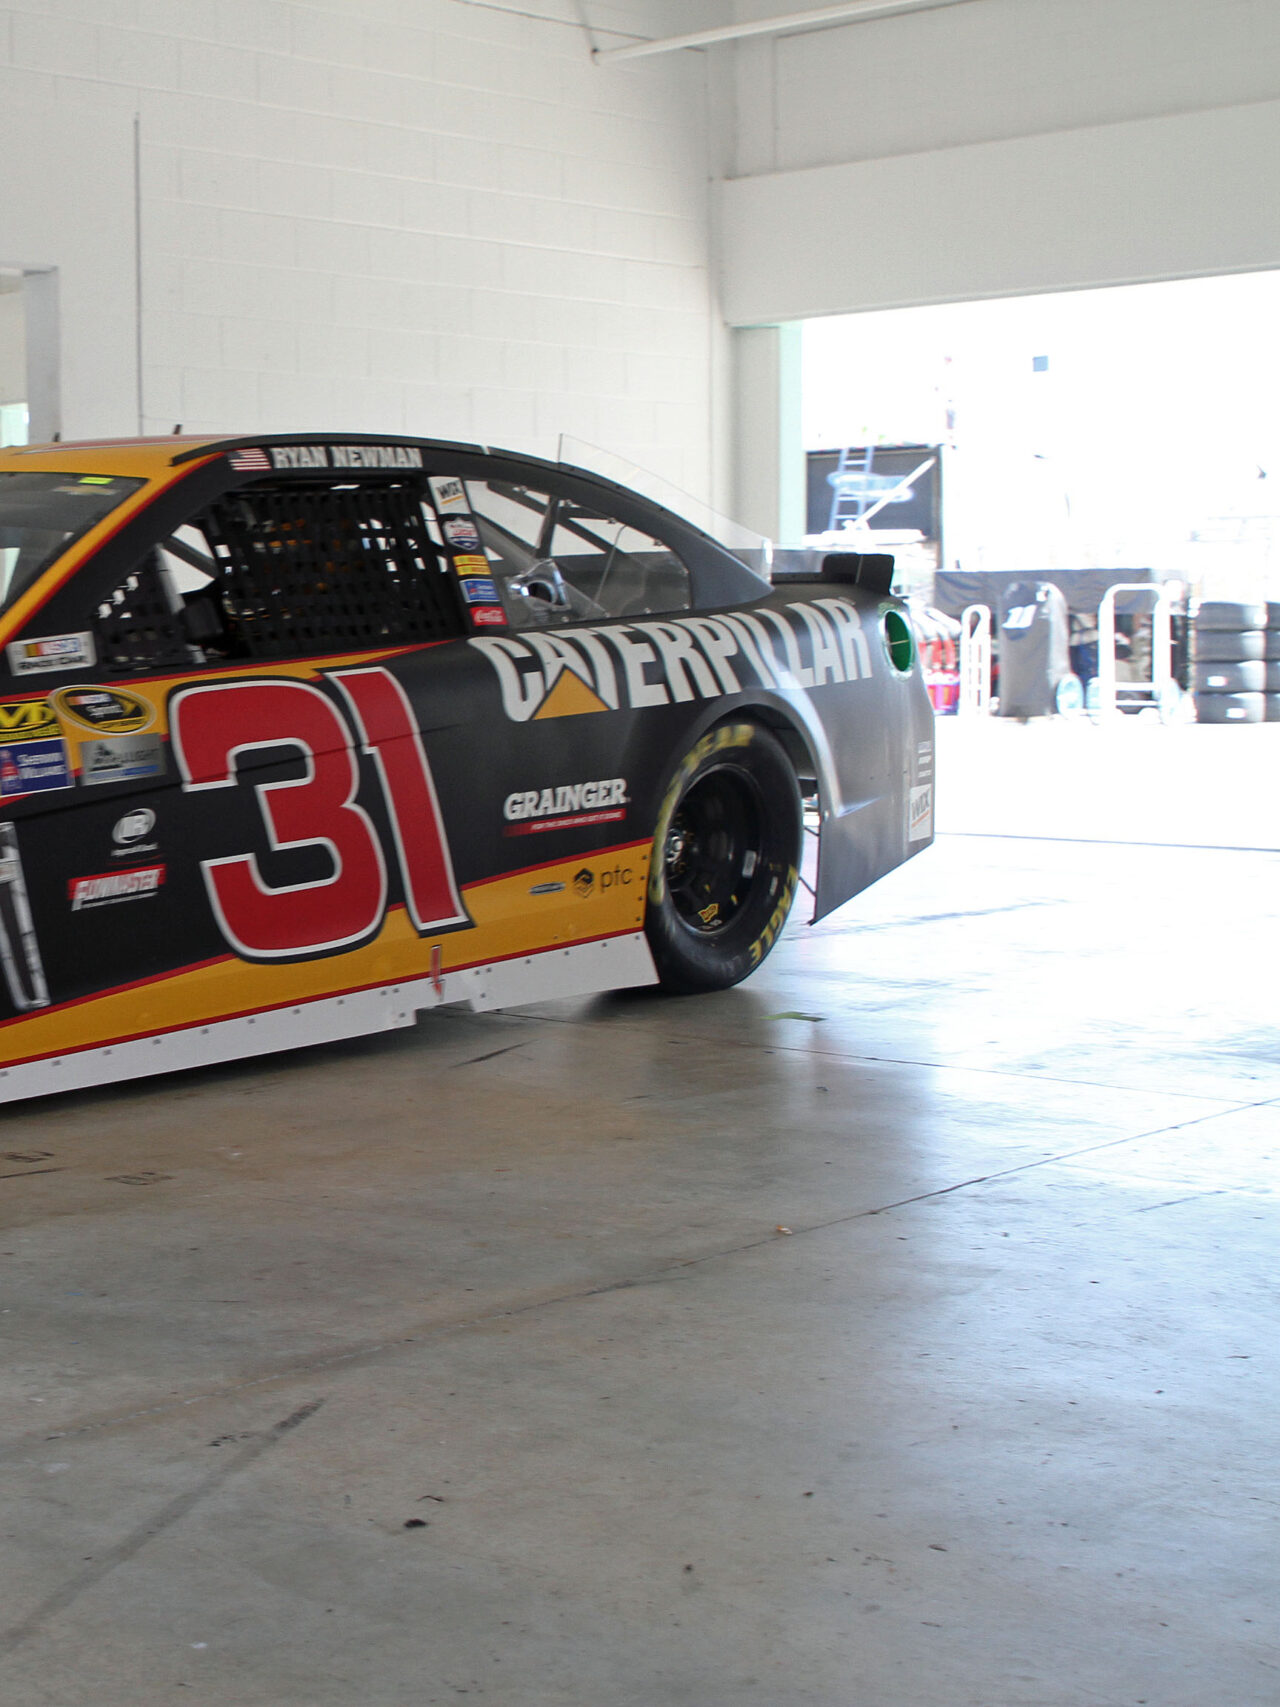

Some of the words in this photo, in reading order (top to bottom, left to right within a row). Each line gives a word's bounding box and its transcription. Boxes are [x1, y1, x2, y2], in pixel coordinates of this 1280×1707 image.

[272, 447, 328, 468] RYAN
[331, 447, 423, 468] NEWMAN
[467, 599, 872, 722] CATERPILLAR
[169, 666, 470, 959] 31
[504, 778, 628, 820] GRAINGER
